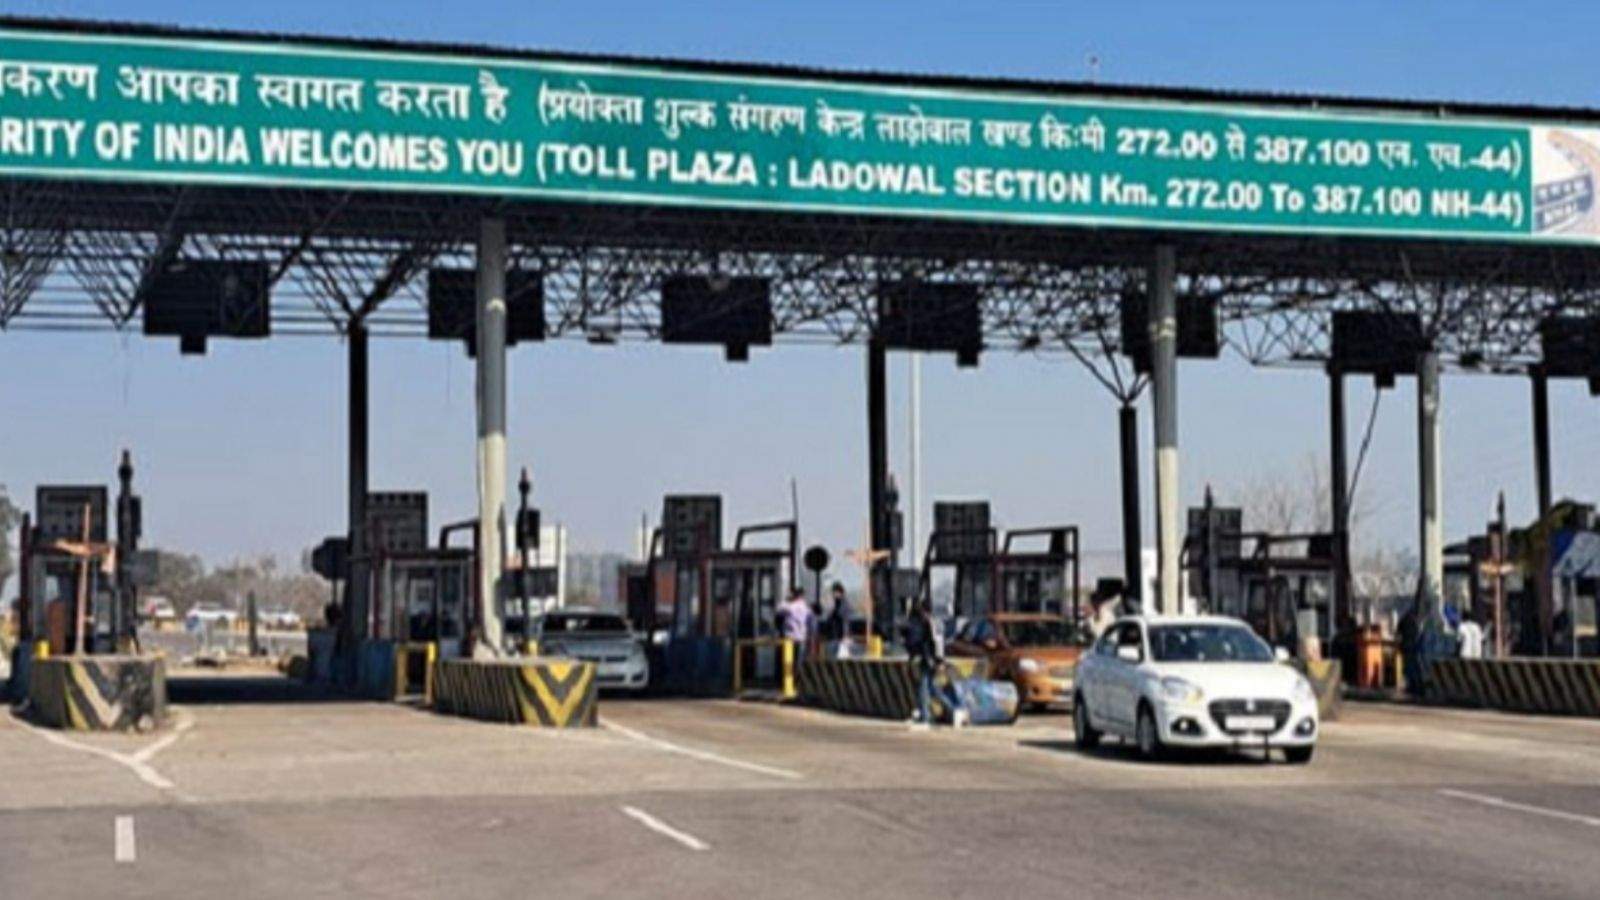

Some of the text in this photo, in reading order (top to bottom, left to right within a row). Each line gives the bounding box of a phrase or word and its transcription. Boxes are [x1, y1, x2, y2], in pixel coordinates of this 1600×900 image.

[0, 60, 98, 100] करण
[115, 64, 240, 106] आपका
[255, 74, 364, 112] स्वागत
[376, 80, 472, 120] करता
[479, 70, 509, 122] है
[654, 98, 716, 139] शुल्क
[1116, 128, 1218, 160] 272.00
[1225, 123, 1246, 161] से
[1254, 134, 1370, 167] 387.100
[95, 121, 141, 160] OF
[154, 123, 251, 165] INDIA
[259, 127, 449, 173] WELCOMES
[457, 139, 524, 177] YOU
[536, 142, 636, 183] (TOLL
[647, 149, 758, 186] PLAZA
[788, 159, 946, 197] LADOWAL
[953, 166, 1092, 204] SECTION
[1100, 174, 1158, 207] Km.
[1166, 178, 1263, 211] 272.00
[1269, 183, 1305, 213] To
[1312, 185, 1423, 217] 387.100
[1431, 189, 1524, 228] NH-44)
